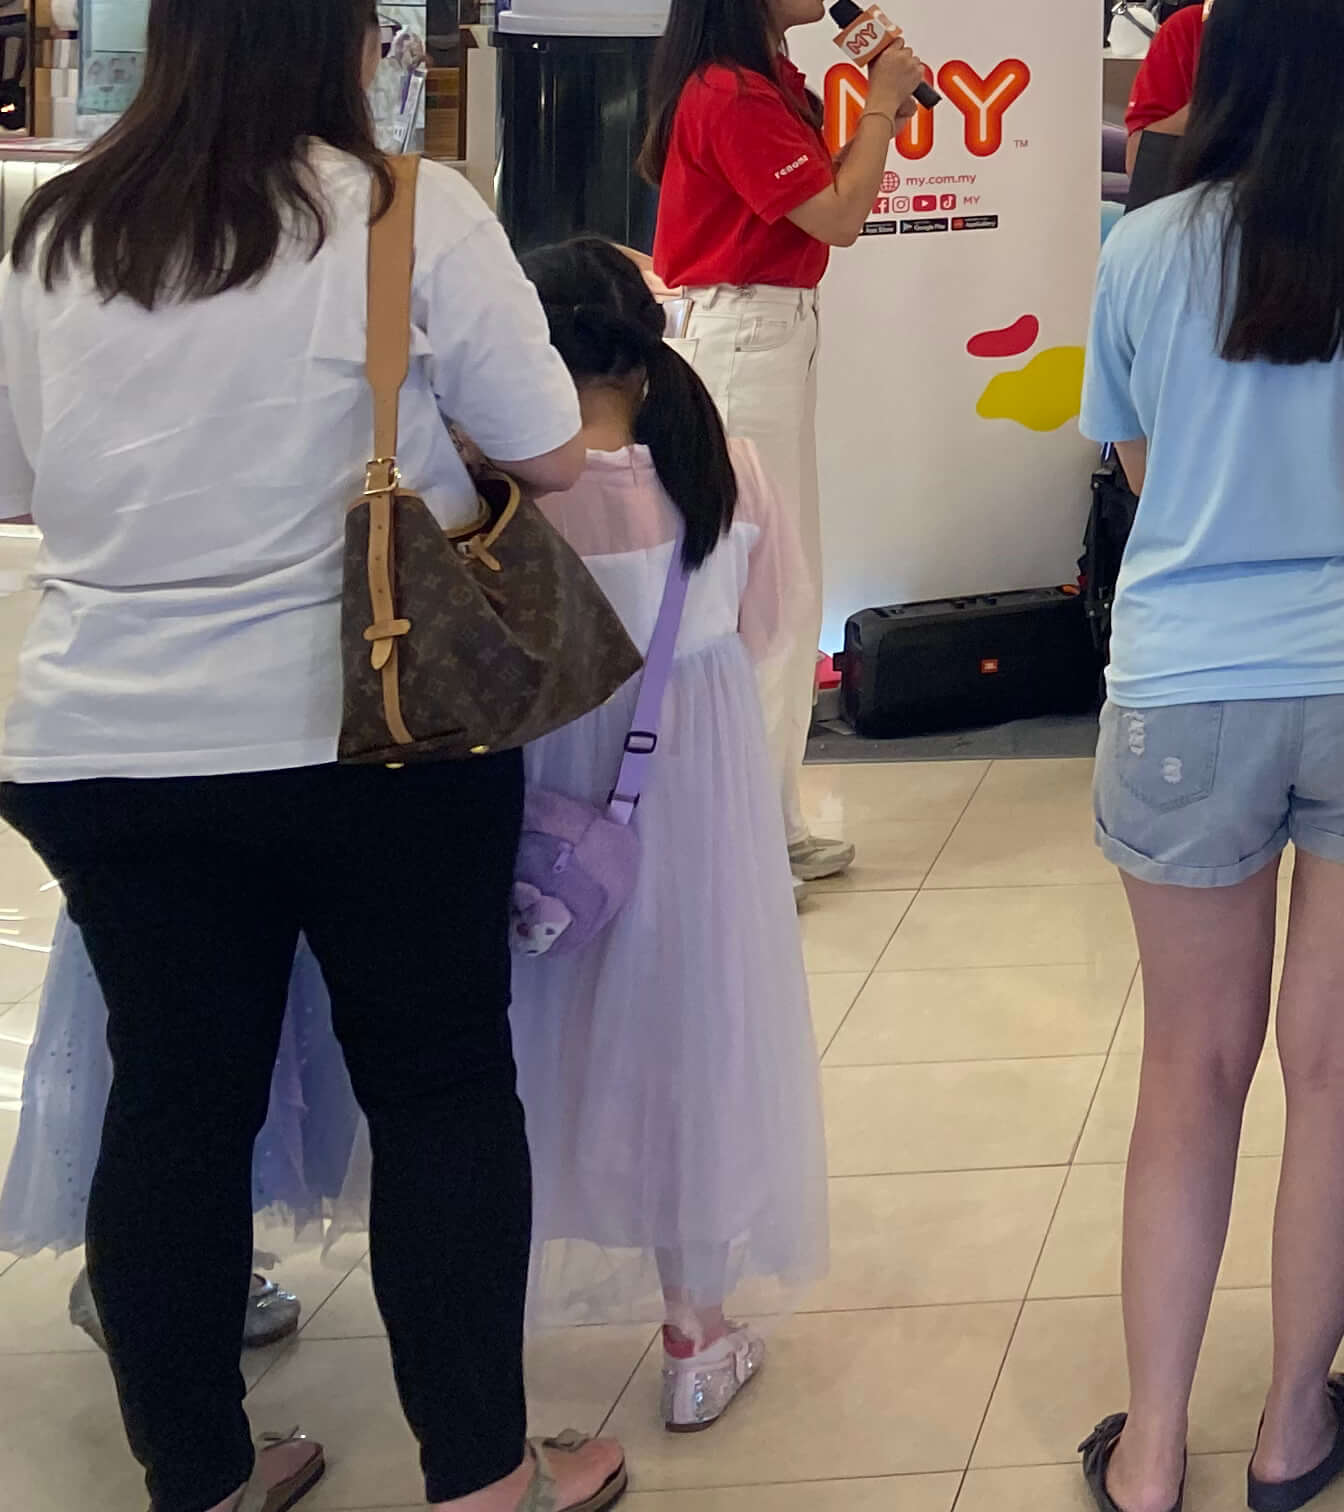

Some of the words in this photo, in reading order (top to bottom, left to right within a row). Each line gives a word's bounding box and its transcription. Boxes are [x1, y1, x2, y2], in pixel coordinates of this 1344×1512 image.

[846, 23, 877, 55] MY
[824, 58, 1031, 160] MY
[906, 173, 977, 187] my.com.my
[963, 196, 980, 205] MY
